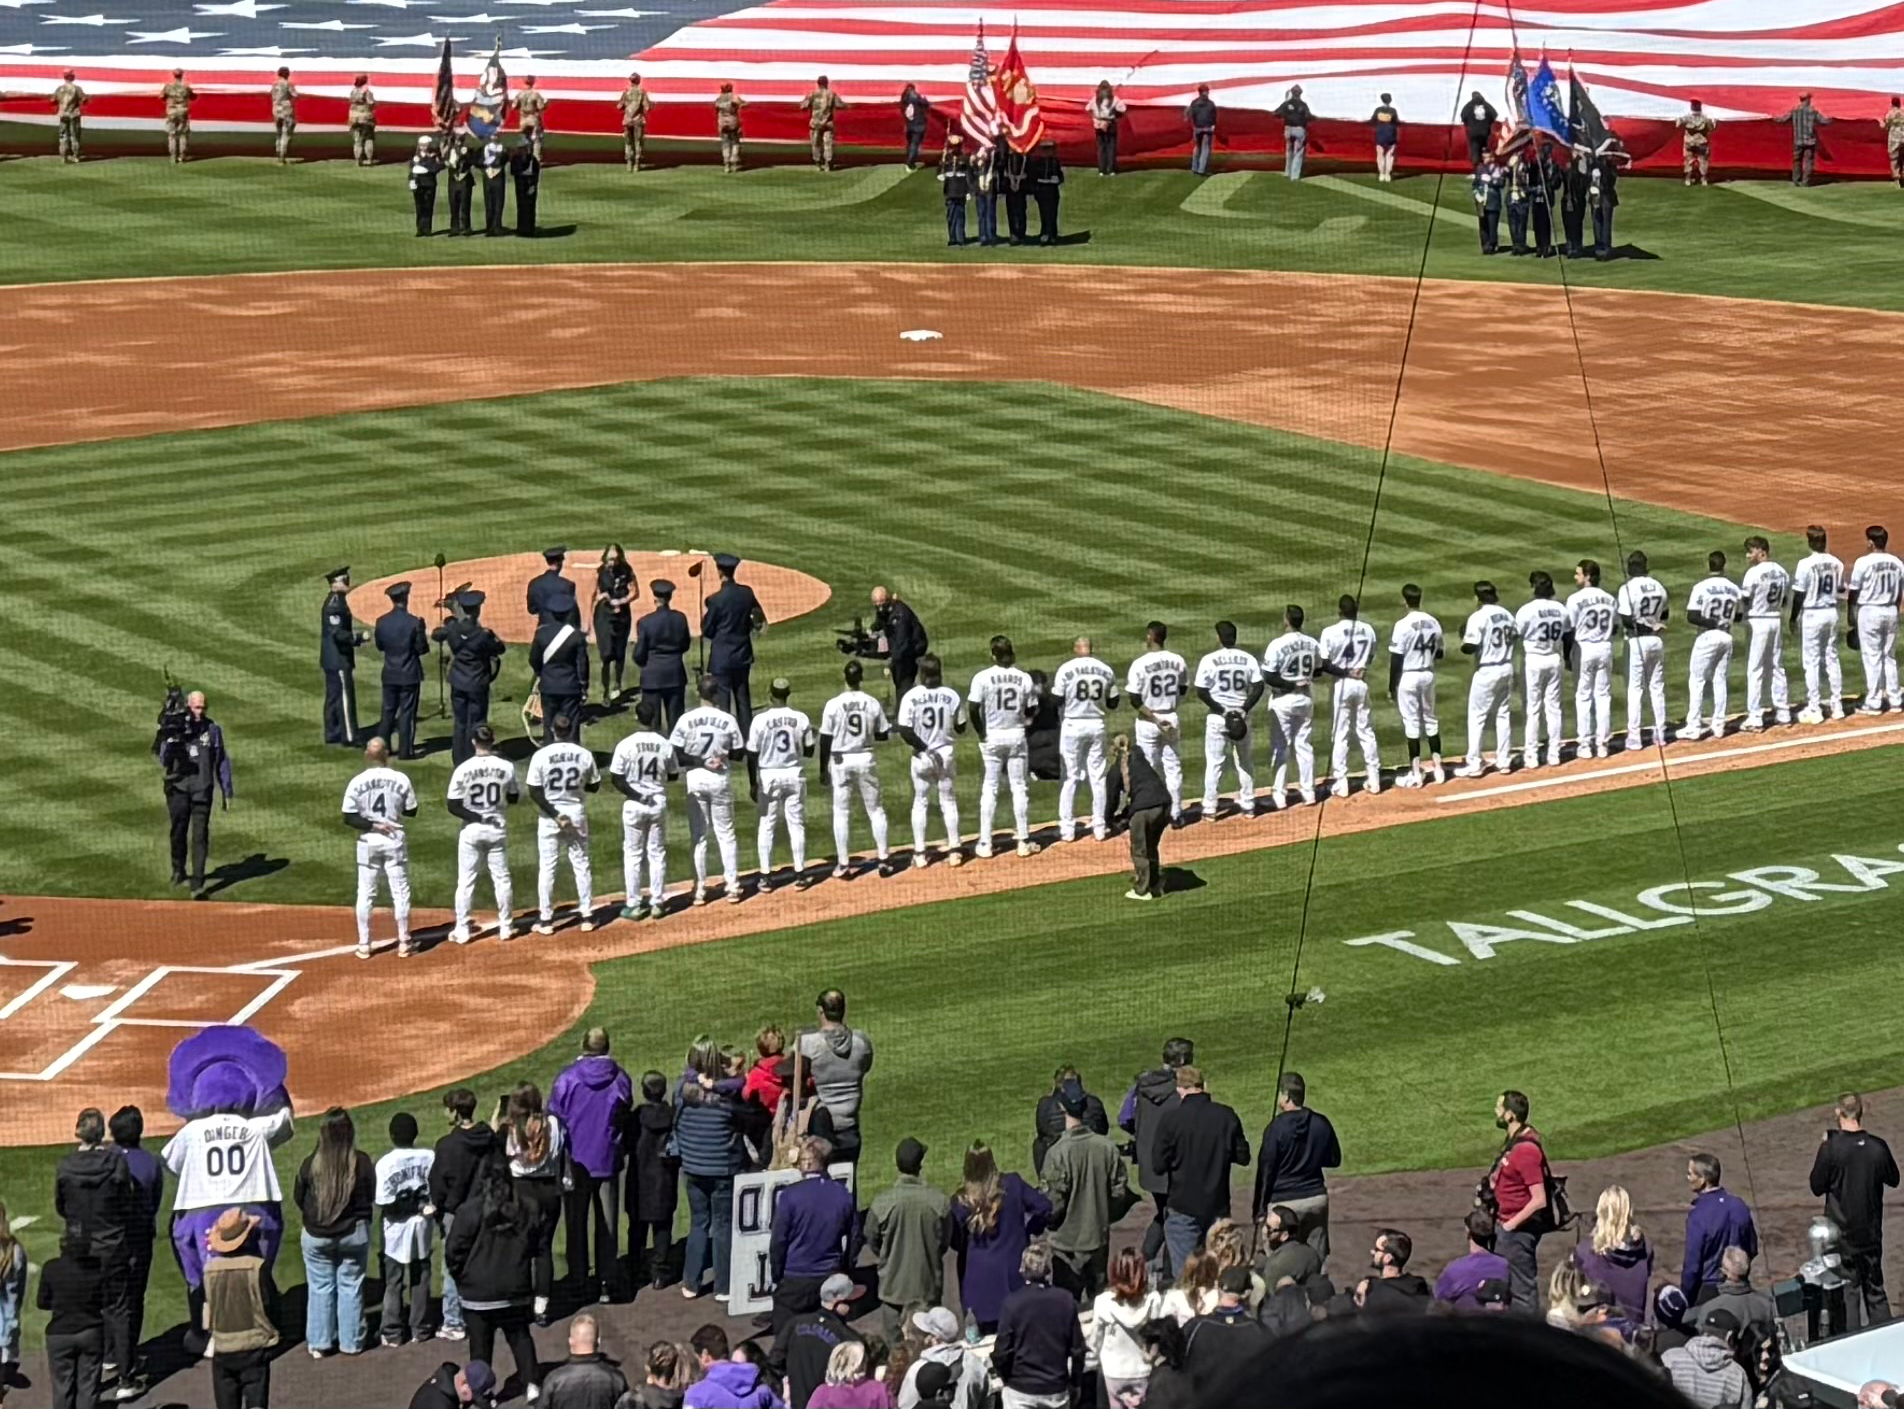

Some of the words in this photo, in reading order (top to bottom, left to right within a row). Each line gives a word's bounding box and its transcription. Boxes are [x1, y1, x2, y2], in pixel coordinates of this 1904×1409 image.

[1640, 595, 1663, 617] 27
[1585, 608, 1612, 630] 32
[1413, 633, 1438, 656] 44
[1286, 654, 1313, 678] 49
[1076, 678, 1105, 702] 83
[1149, 674, 1179, 698] 62
[1218, 669, 1247, 692] 56
[998, 689, 1019, 711] 12
[847, 713, 862, 738] 9
[922, 706, 945, 731] 31
[700, 732, 715, 756] 7
[775, 729, 791, 753] 3
[548, 768, 581, 791] 22
[637, 756, 658, 781] 14
[371, 792, 387, 818] 4
[470, 782, 502, 807] 20
[203, 1125, 250, 1144] DINGER
[206, 1145, 246, 1177] 00
